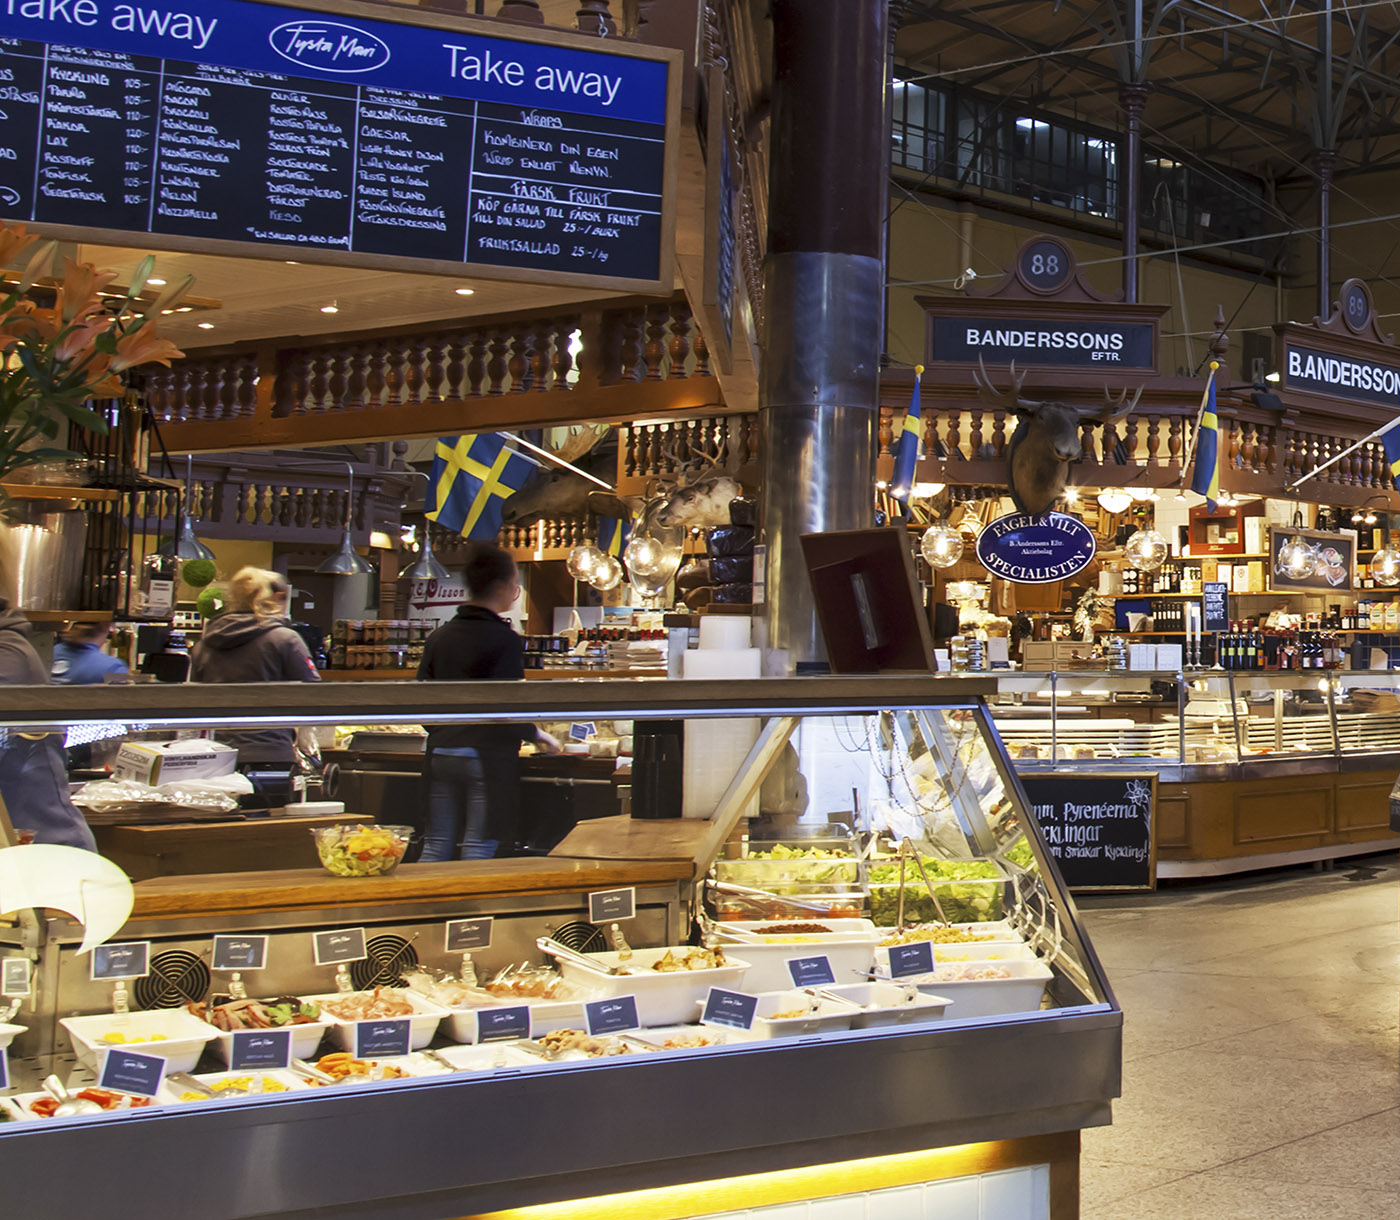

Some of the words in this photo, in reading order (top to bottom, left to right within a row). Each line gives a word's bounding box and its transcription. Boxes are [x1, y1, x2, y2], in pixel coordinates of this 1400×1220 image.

[112, 4, 218, 49] away
[286, 26, 332, 56] Tysta
[332, 35, 377, 60] Mari
[50, 67, 110, 85] KYCKLING
[443, 44, 525, 86] Take
[535, 67, 622, 106] away
[47, 85, 86, 99] PARMA
[163, 95, 198, 106] BACON
[162, 106, 209, 120] BROCCOLI
[521, 109, 563, 128] WRAPS
[46, 135, 68, 147] LAX
[361, 125, 412, 142] CAESAR
[484, 130, 553, 152] KOMBINERA
[561, 143, 580, 155] DIN
[587, 147, 619, 160] EGEN
[44, 152, 94, 166] ROSTBIFF
[482, 150, 514, 166] WRAP
[520, 158, 562, 171] ENLIGT
[569, 161, 613, 178] MENYN.
[40, 166, 93, 182] TONFISK
[40, 182, 106, 203] VEGETARISK
[160, 187, 197, 202] MELON
[357, 185, 389, 197] RHODE
[392, 188, 425, 201] ISLAND
[569, 188, 612, 207] FRUKT
[157, 202, 218, 220] MOZZARELLA
[478, 196, 500, 211] KÖP
[544, 207, 564, 218] TILL
[607, 214, 642, 226] FRUKT
[472, 212, 493, 223] TILL
[496, 216, 512, 226] DIN
[514, 218, 546, 229] SALLAD
[478, 237, 560, 255] FRUKTSALLAD
[1031, 254, 1059, 275] 88
[1350, 296, 1364, 317] 89
[1091, 352, 1121, 361] EFTR.
[986, 550, 1087, 579] SPECIALISTEN
[427, 579, 465, 598] Olsson
[1063, 802, 1138, 822] Pyrenéerna
